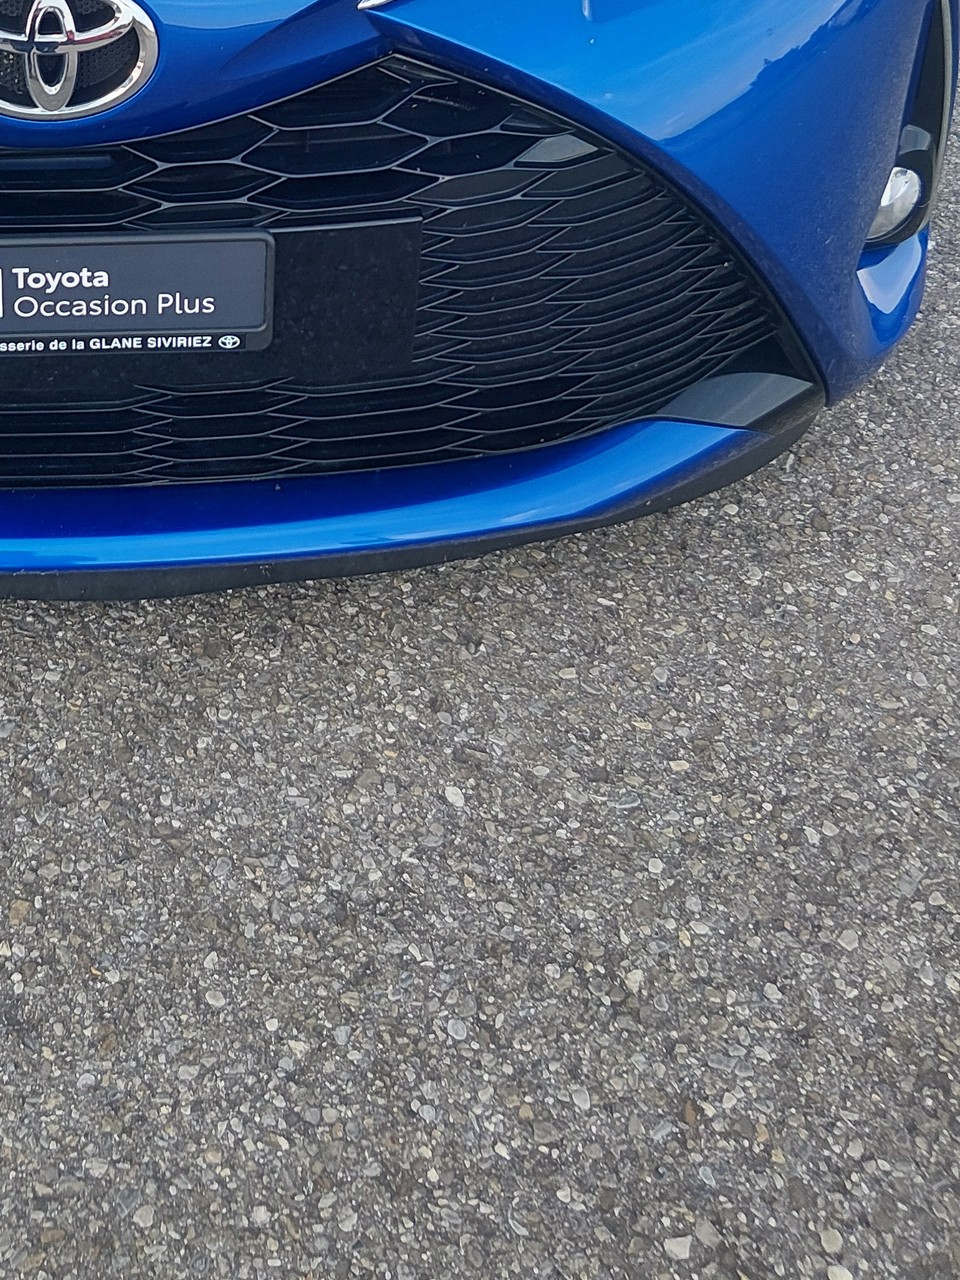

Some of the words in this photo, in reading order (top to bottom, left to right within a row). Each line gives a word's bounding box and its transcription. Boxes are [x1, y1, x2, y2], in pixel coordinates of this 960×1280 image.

[11, 267, 109, 293] Toyota
[13, 294, 146, 317] Occasion
[157, 292, 215, 315] Plus
[48, 338, 68, 351] de
[71, 337, 86, 351] la
[89, 336, 143, 350] GLANE
[147, 334, 213, 349] SIVIRIEZ
